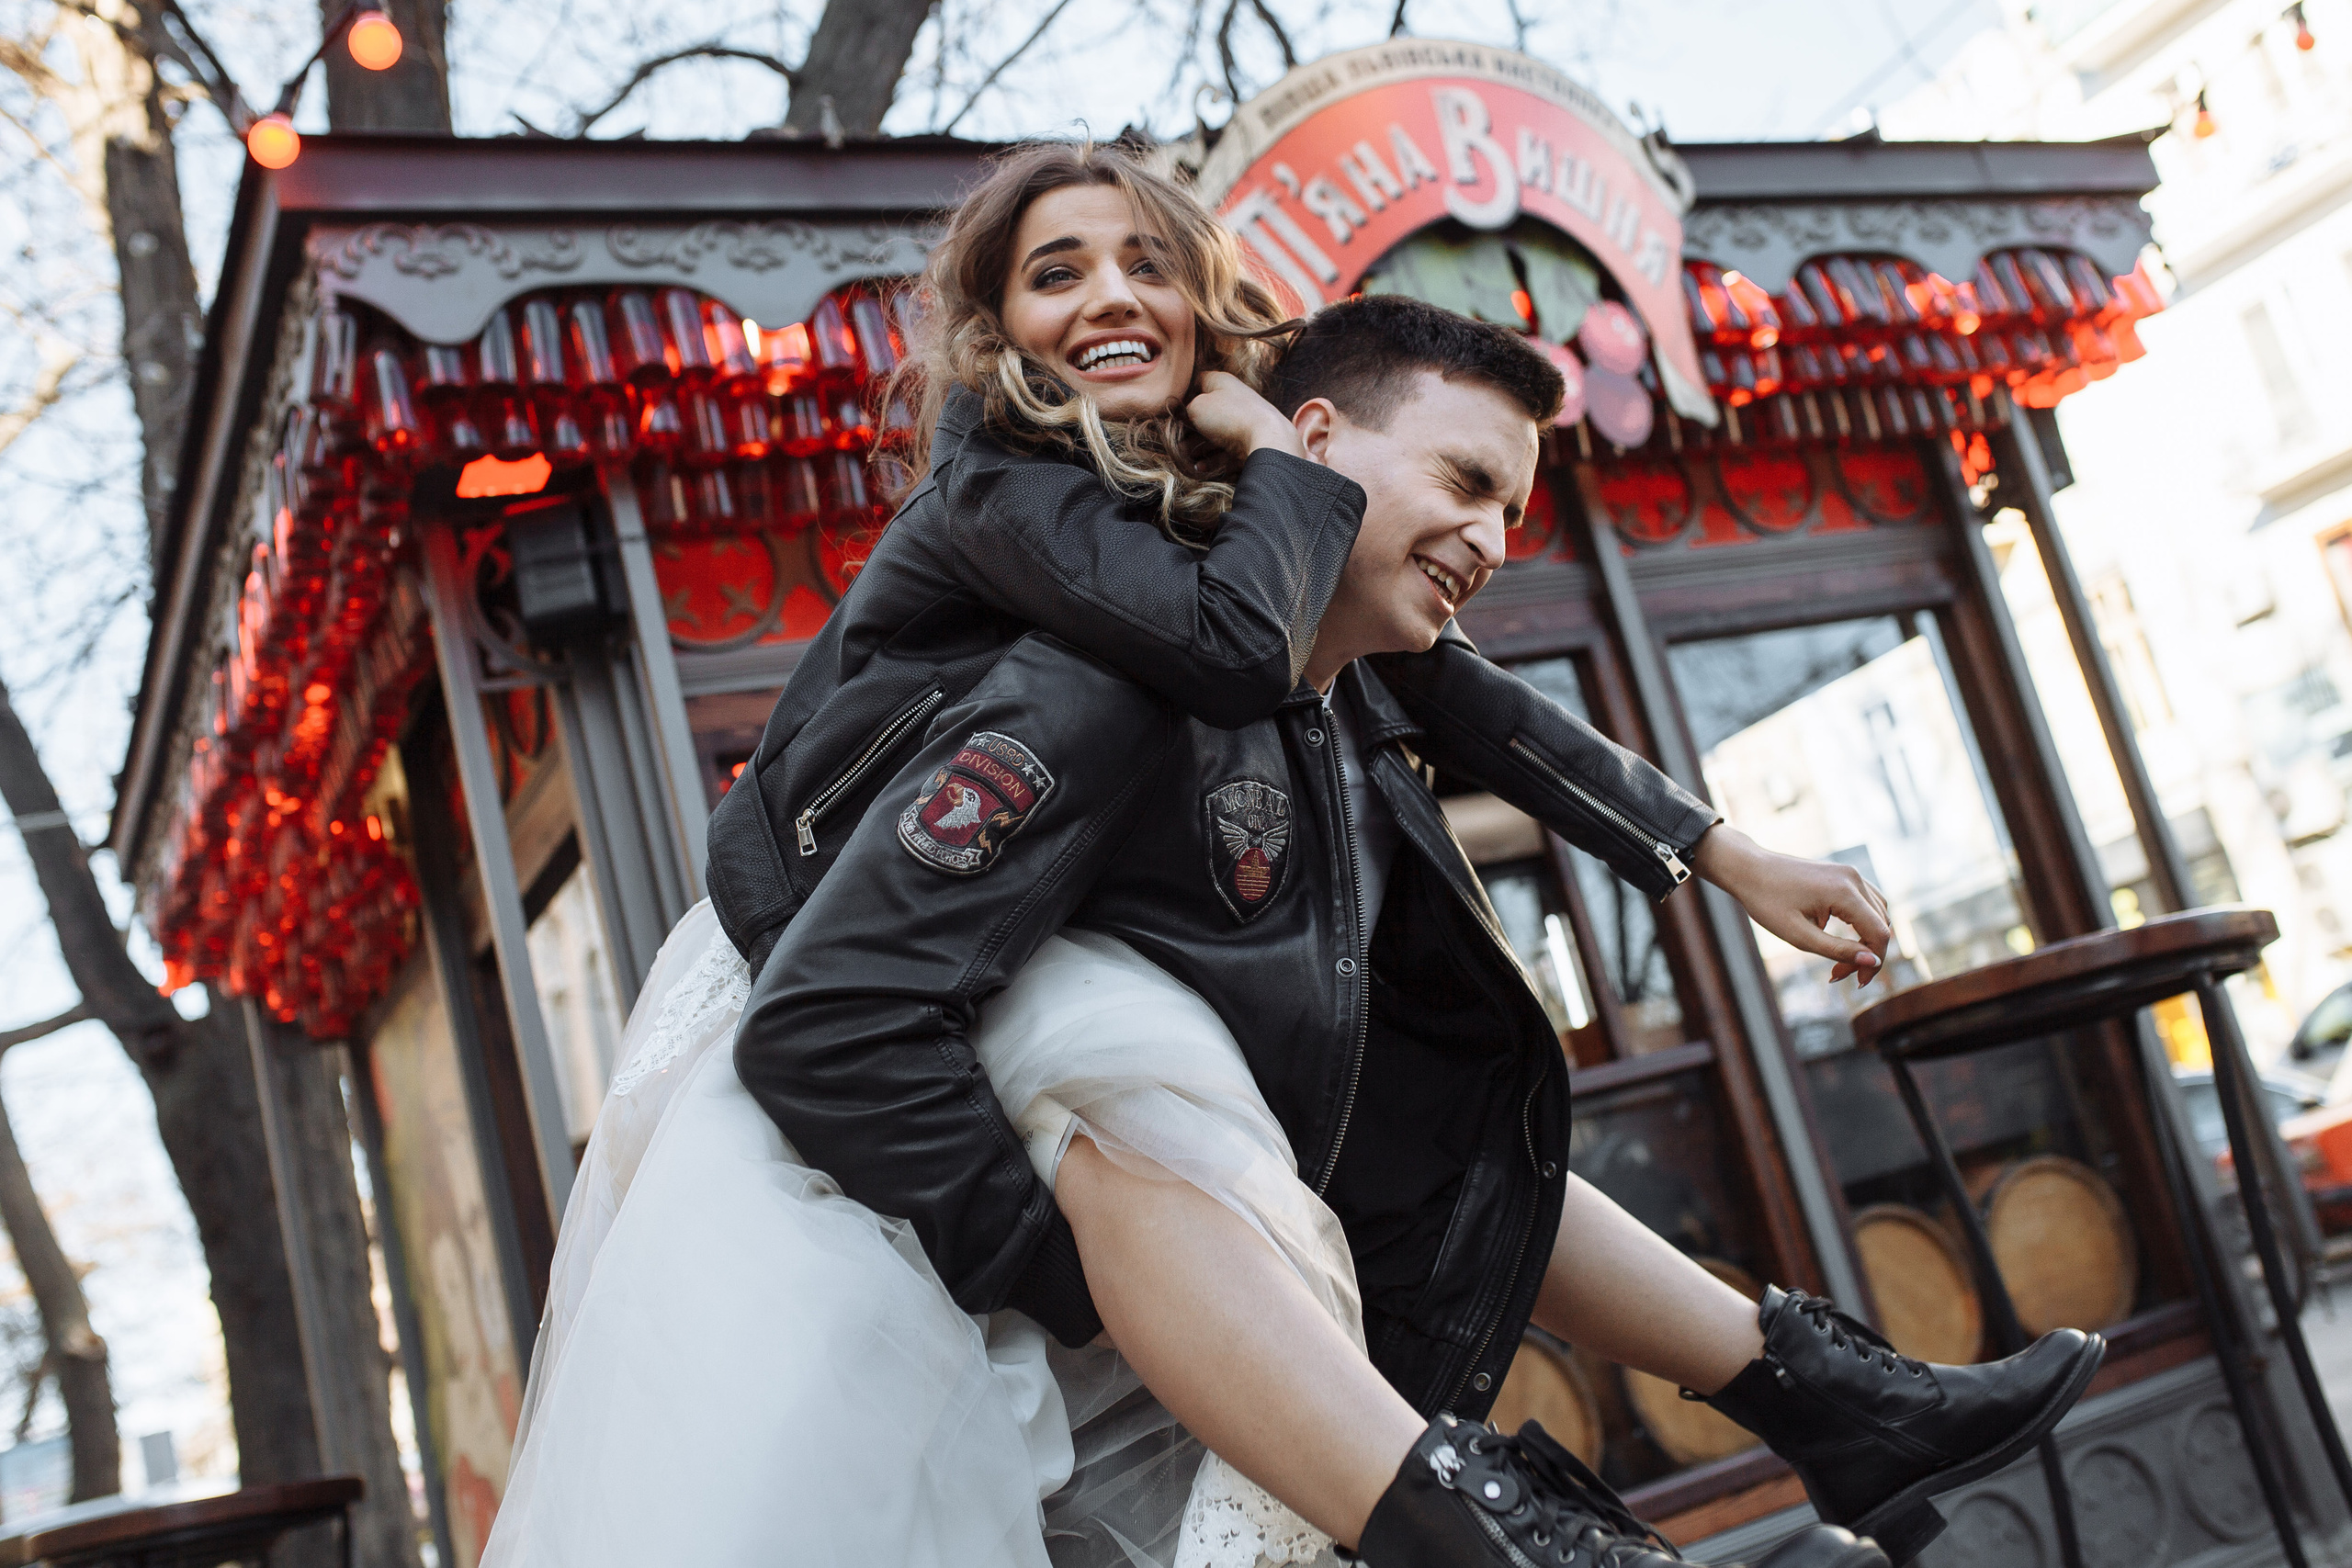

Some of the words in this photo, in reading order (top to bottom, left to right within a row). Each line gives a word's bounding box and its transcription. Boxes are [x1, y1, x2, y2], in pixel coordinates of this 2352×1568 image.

[1436, 85, 1669, 286] ВИШНЯ
[988, 738, 1026, 766] USRD
[958, 751, 1026, 799] DIVISION
[910, 831, 936, 853] ARMED
